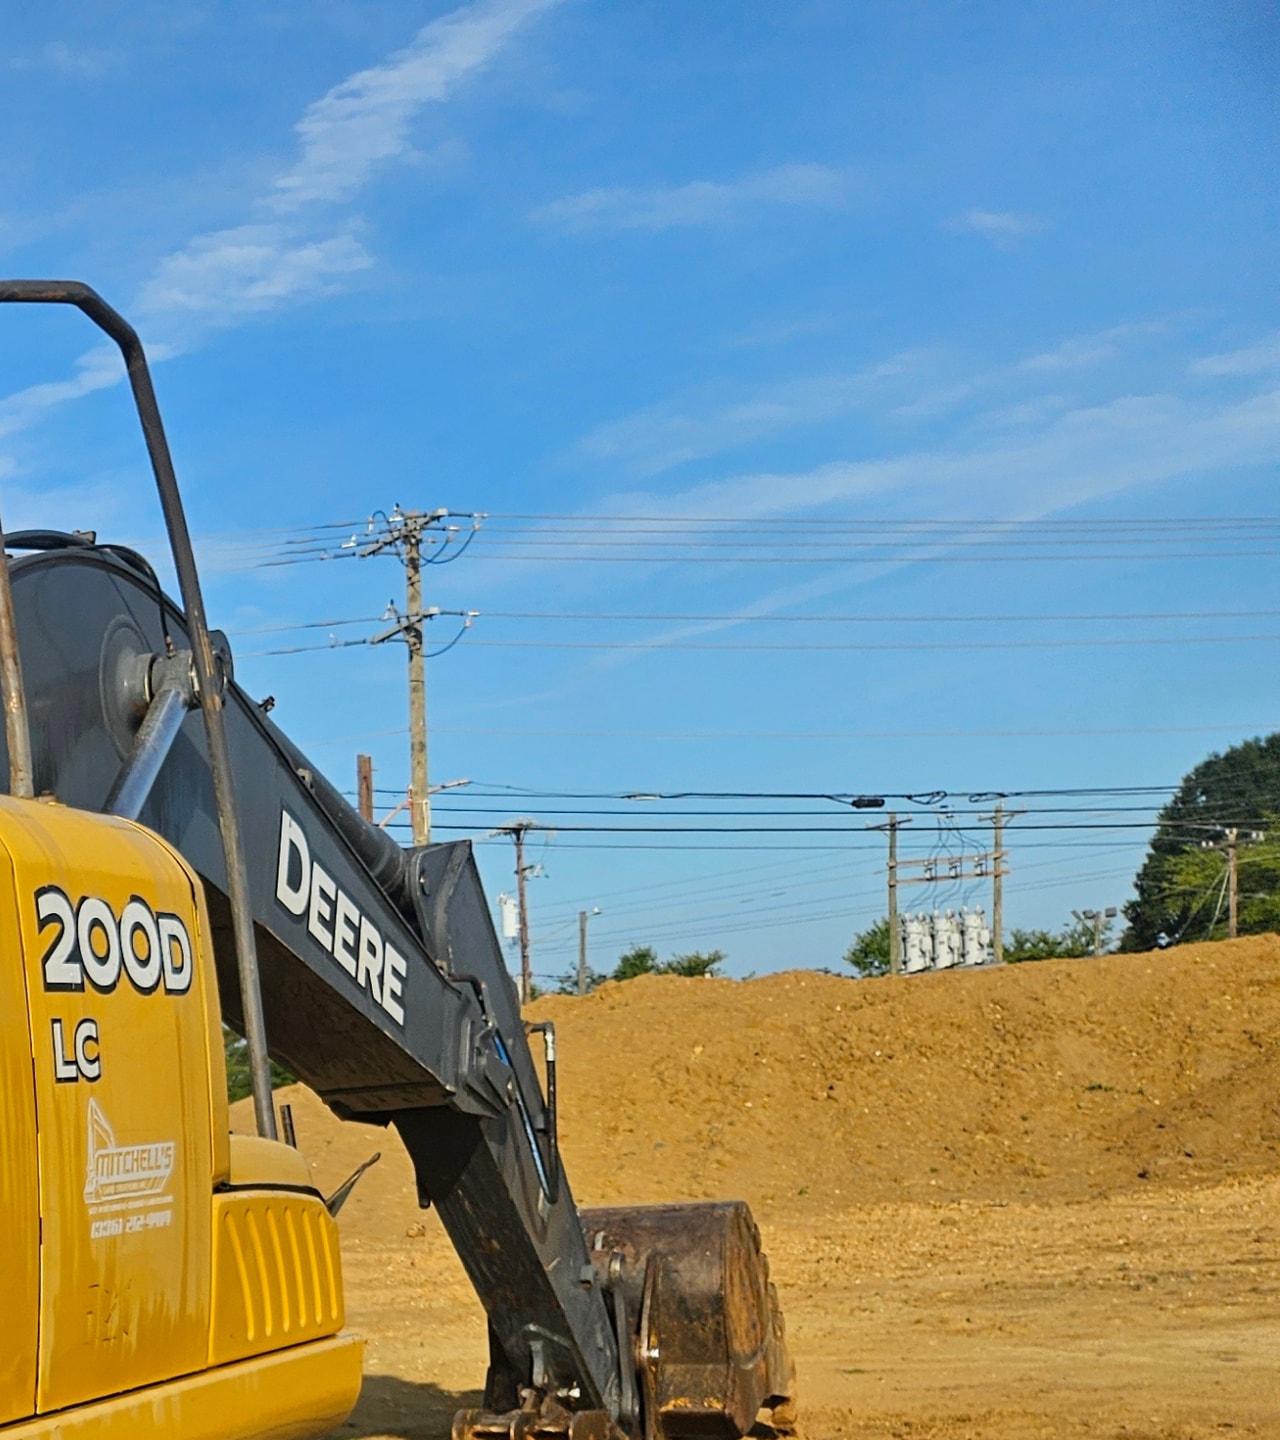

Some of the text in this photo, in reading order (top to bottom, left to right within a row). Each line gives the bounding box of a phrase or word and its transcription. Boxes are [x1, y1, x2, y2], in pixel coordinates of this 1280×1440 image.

[36, 889, 194, 993] 200D
[276, 809, 407, 1027] DEERE
[51, 1017, 101, 1082] LC
[95, 1145, 173, 1179] MITCHELL'S
